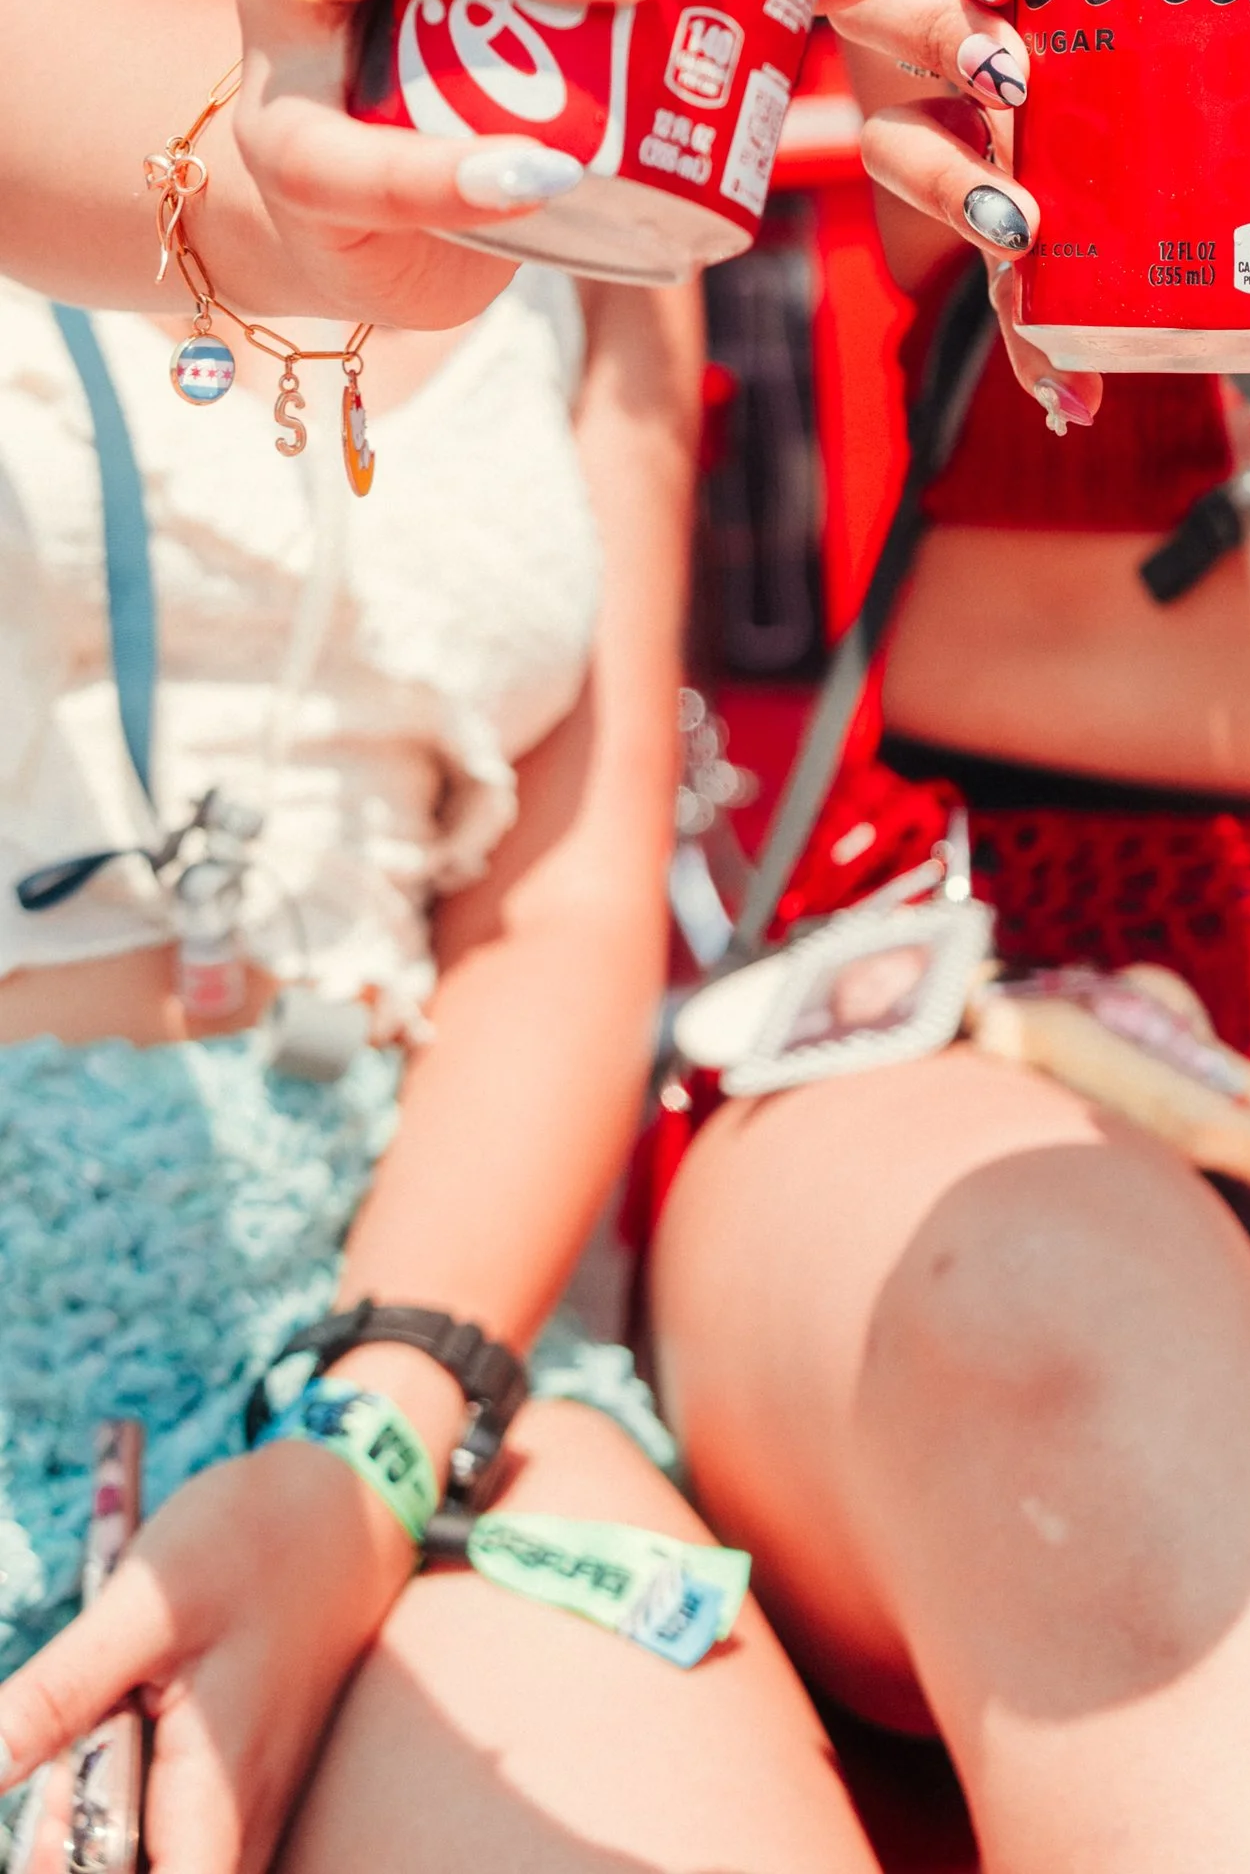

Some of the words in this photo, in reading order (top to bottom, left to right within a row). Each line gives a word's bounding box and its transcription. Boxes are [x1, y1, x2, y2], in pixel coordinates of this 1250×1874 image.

[1052, 242, 1099, 258] COLA
[1158, 241, 1174, 261] 12
[1177, 241, 1194, 261] FL
[1196, 241, 1217, 261] OZ
[1148, 265, 1182, 287] (355
[1185, 265, 1216, 287] mL)
